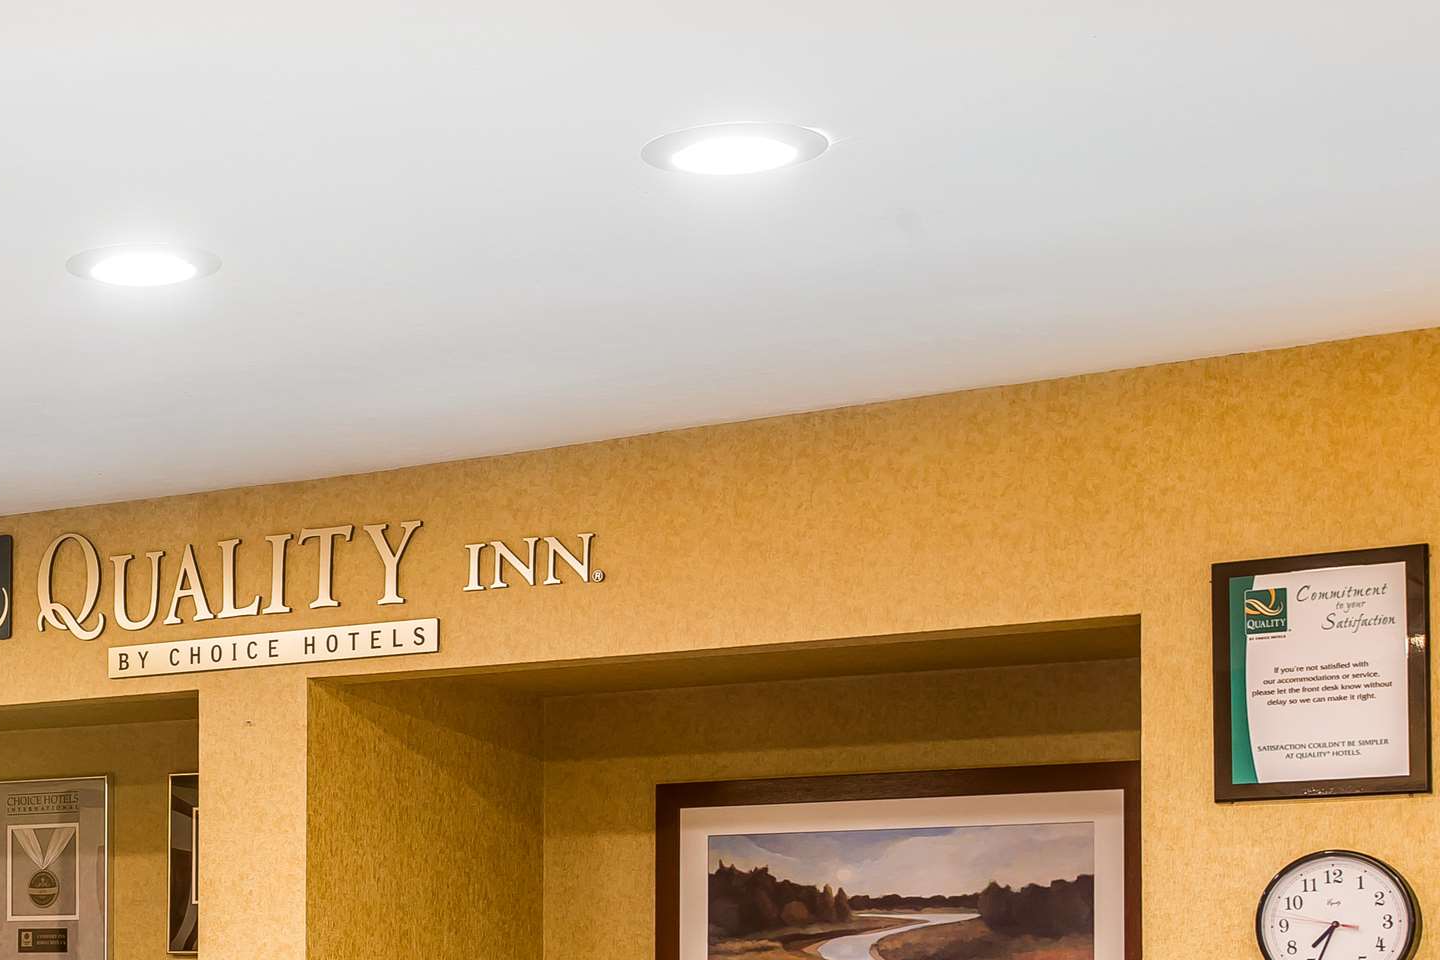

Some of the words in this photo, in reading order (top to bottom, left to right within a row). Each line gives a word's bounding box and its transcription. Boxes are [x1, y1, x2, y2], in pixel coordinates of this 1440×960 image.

[37, 520, 423, 640] QUALITY
[463, 533, 594, 592] INN
[1296, 584, 1388, 602] Commitment
[1346, 601, 1366, 613] your
[1247, 618, 1286, 630] QUALITY
[1321, 612, 1396, 634] Satisfaction
[118, 651, 149, 671] BY
[169, 640, 279, 666] CHOICE
[304, 627, 426, 654] HOTELS
[1280, 666, 1304, 674] you're
[1320, 662, 1350, 670] satisfied
[1277, 674, 1340, 684] accommodations
[1252, 688, 1275, 698] please
[1357, 693, 1376, 701] right.
[1257, 744, 1306, 752] SATISFACTION
[1308, 740, 1345, 749] COULDN'T
[7, 796, 41, 806] CHOICE
[44, 794, 78, 804] HOTELS
[1324, 869, 1343, 884] 12
[1357, 876, 1365, 890] 1
[1302, 878, 1317, 892] 11
[1285, 895, 1303, 910] 10
[1375, 891, 1385, 906] 2
[1279, 919, 1289, 933] 9
[1383, 914, 1393, 929] 3
[1287, 940, 1297, 955] 8
[1376, 936, 1386, 952] 4
